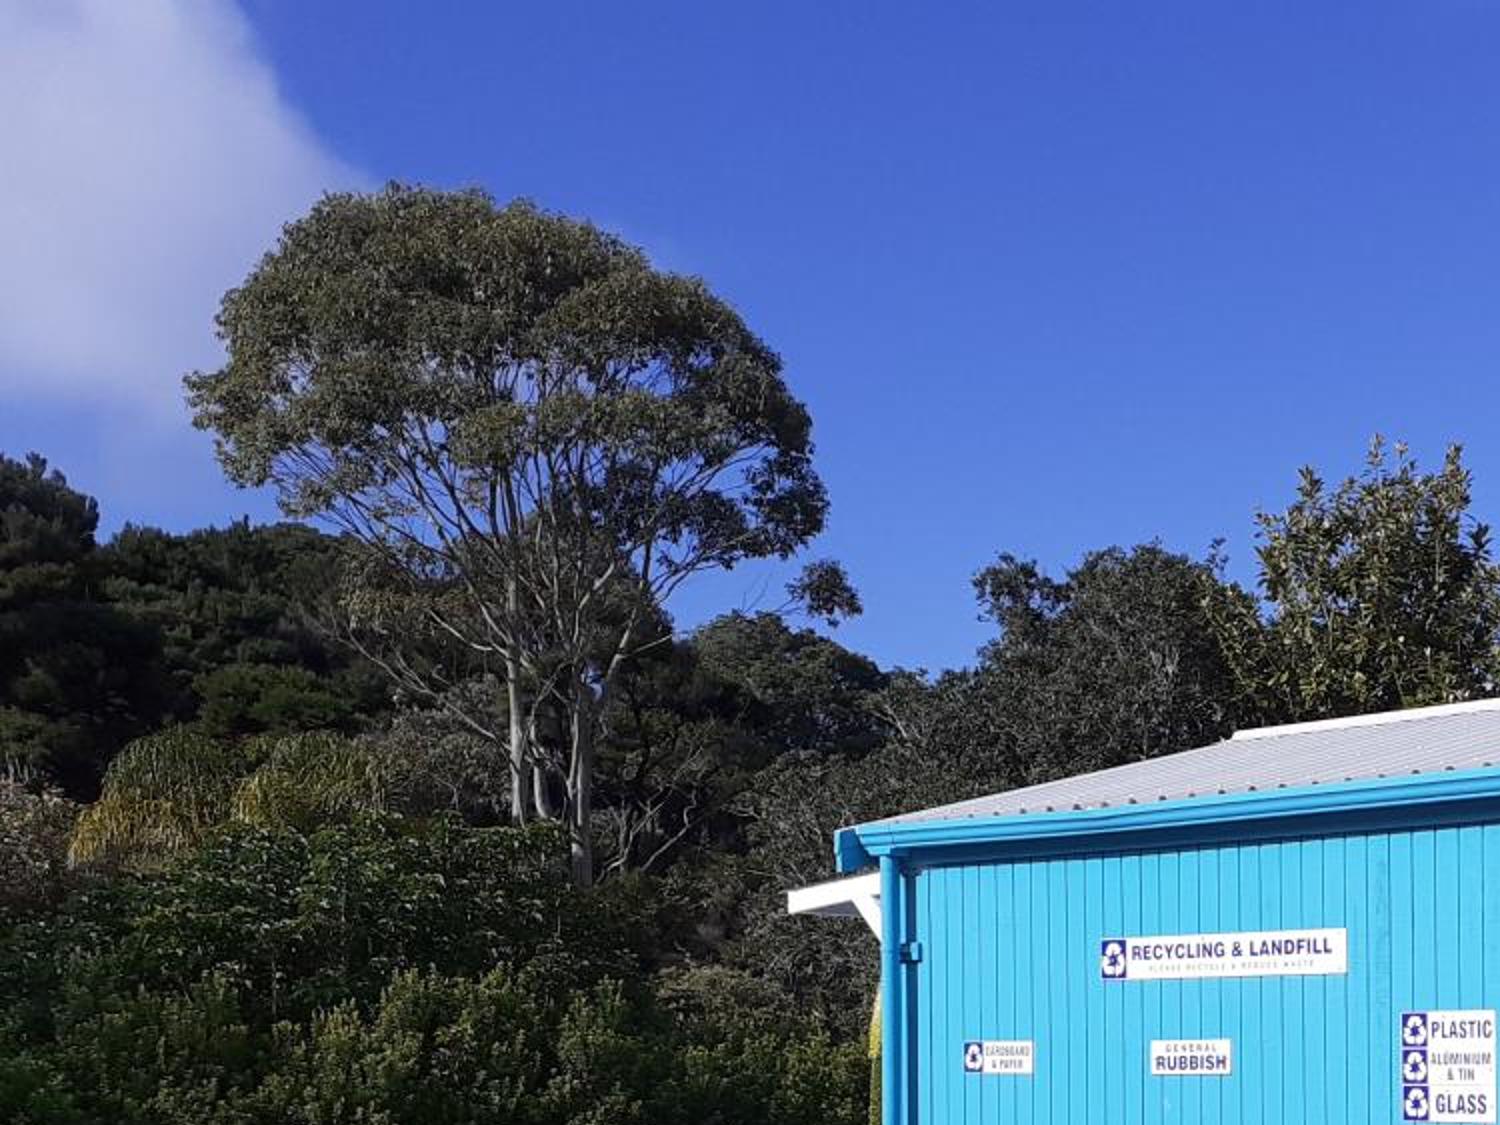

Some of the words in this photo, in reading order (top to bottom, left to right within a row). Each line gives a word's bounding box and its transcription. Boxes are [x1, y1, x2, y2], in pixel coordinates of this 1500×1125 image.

[1131, 941, 1225, 961] RECYCLING
[1231, 940, 1243, 957] &
[1249, 936, 1333, 957] LANDFILL
[1431, 1019, 1493, 1039] PLASTIC
[1166, 1043, 1216, 1053] GENERAL
[1156, 1055, 1227, 1071] RUBBISH
[1431, 1052, 1492, 1065] ALUMINIUM
[1447, 1068, 1454, 1081] &
[1458, 1068, 1475, 1081] TIN
[1436, 1093, 1487, 1115] GLASS
